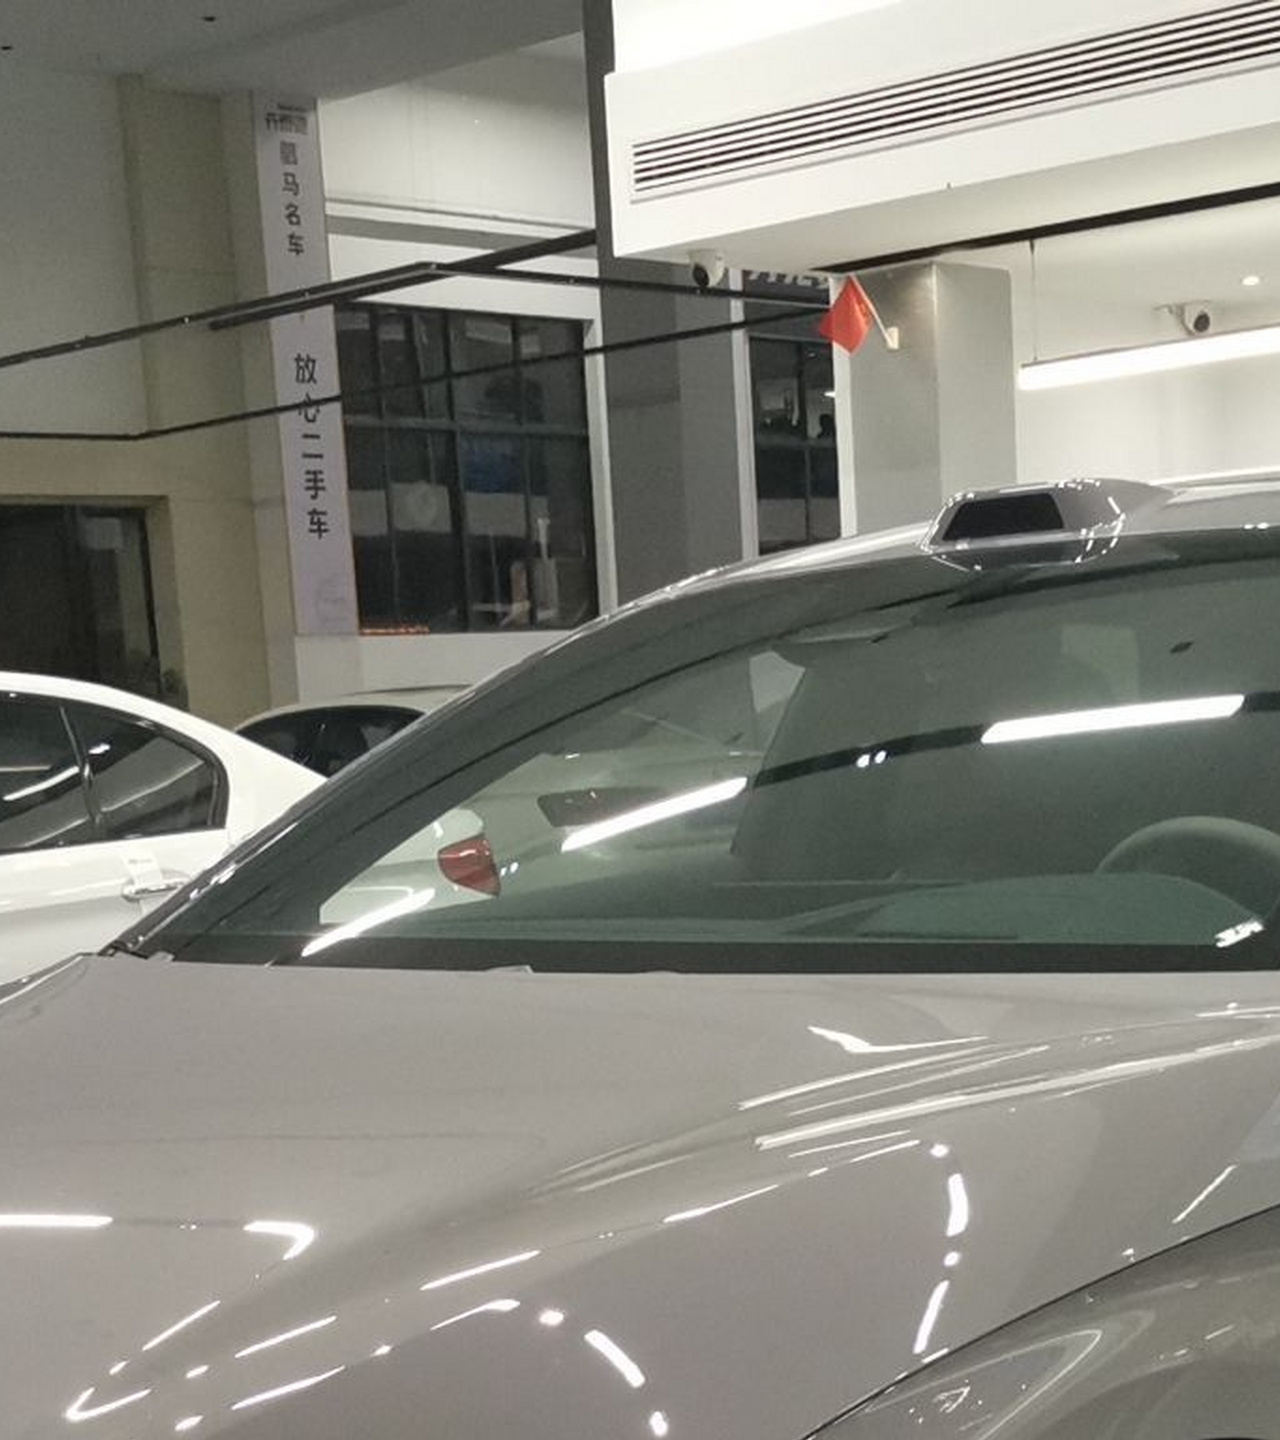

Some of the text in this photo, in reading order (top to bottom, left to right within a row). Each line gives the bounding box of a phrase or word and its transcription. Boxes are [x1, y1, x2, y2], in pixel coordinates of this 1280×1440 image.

[294, 353, 330, 540] 放心二手车
